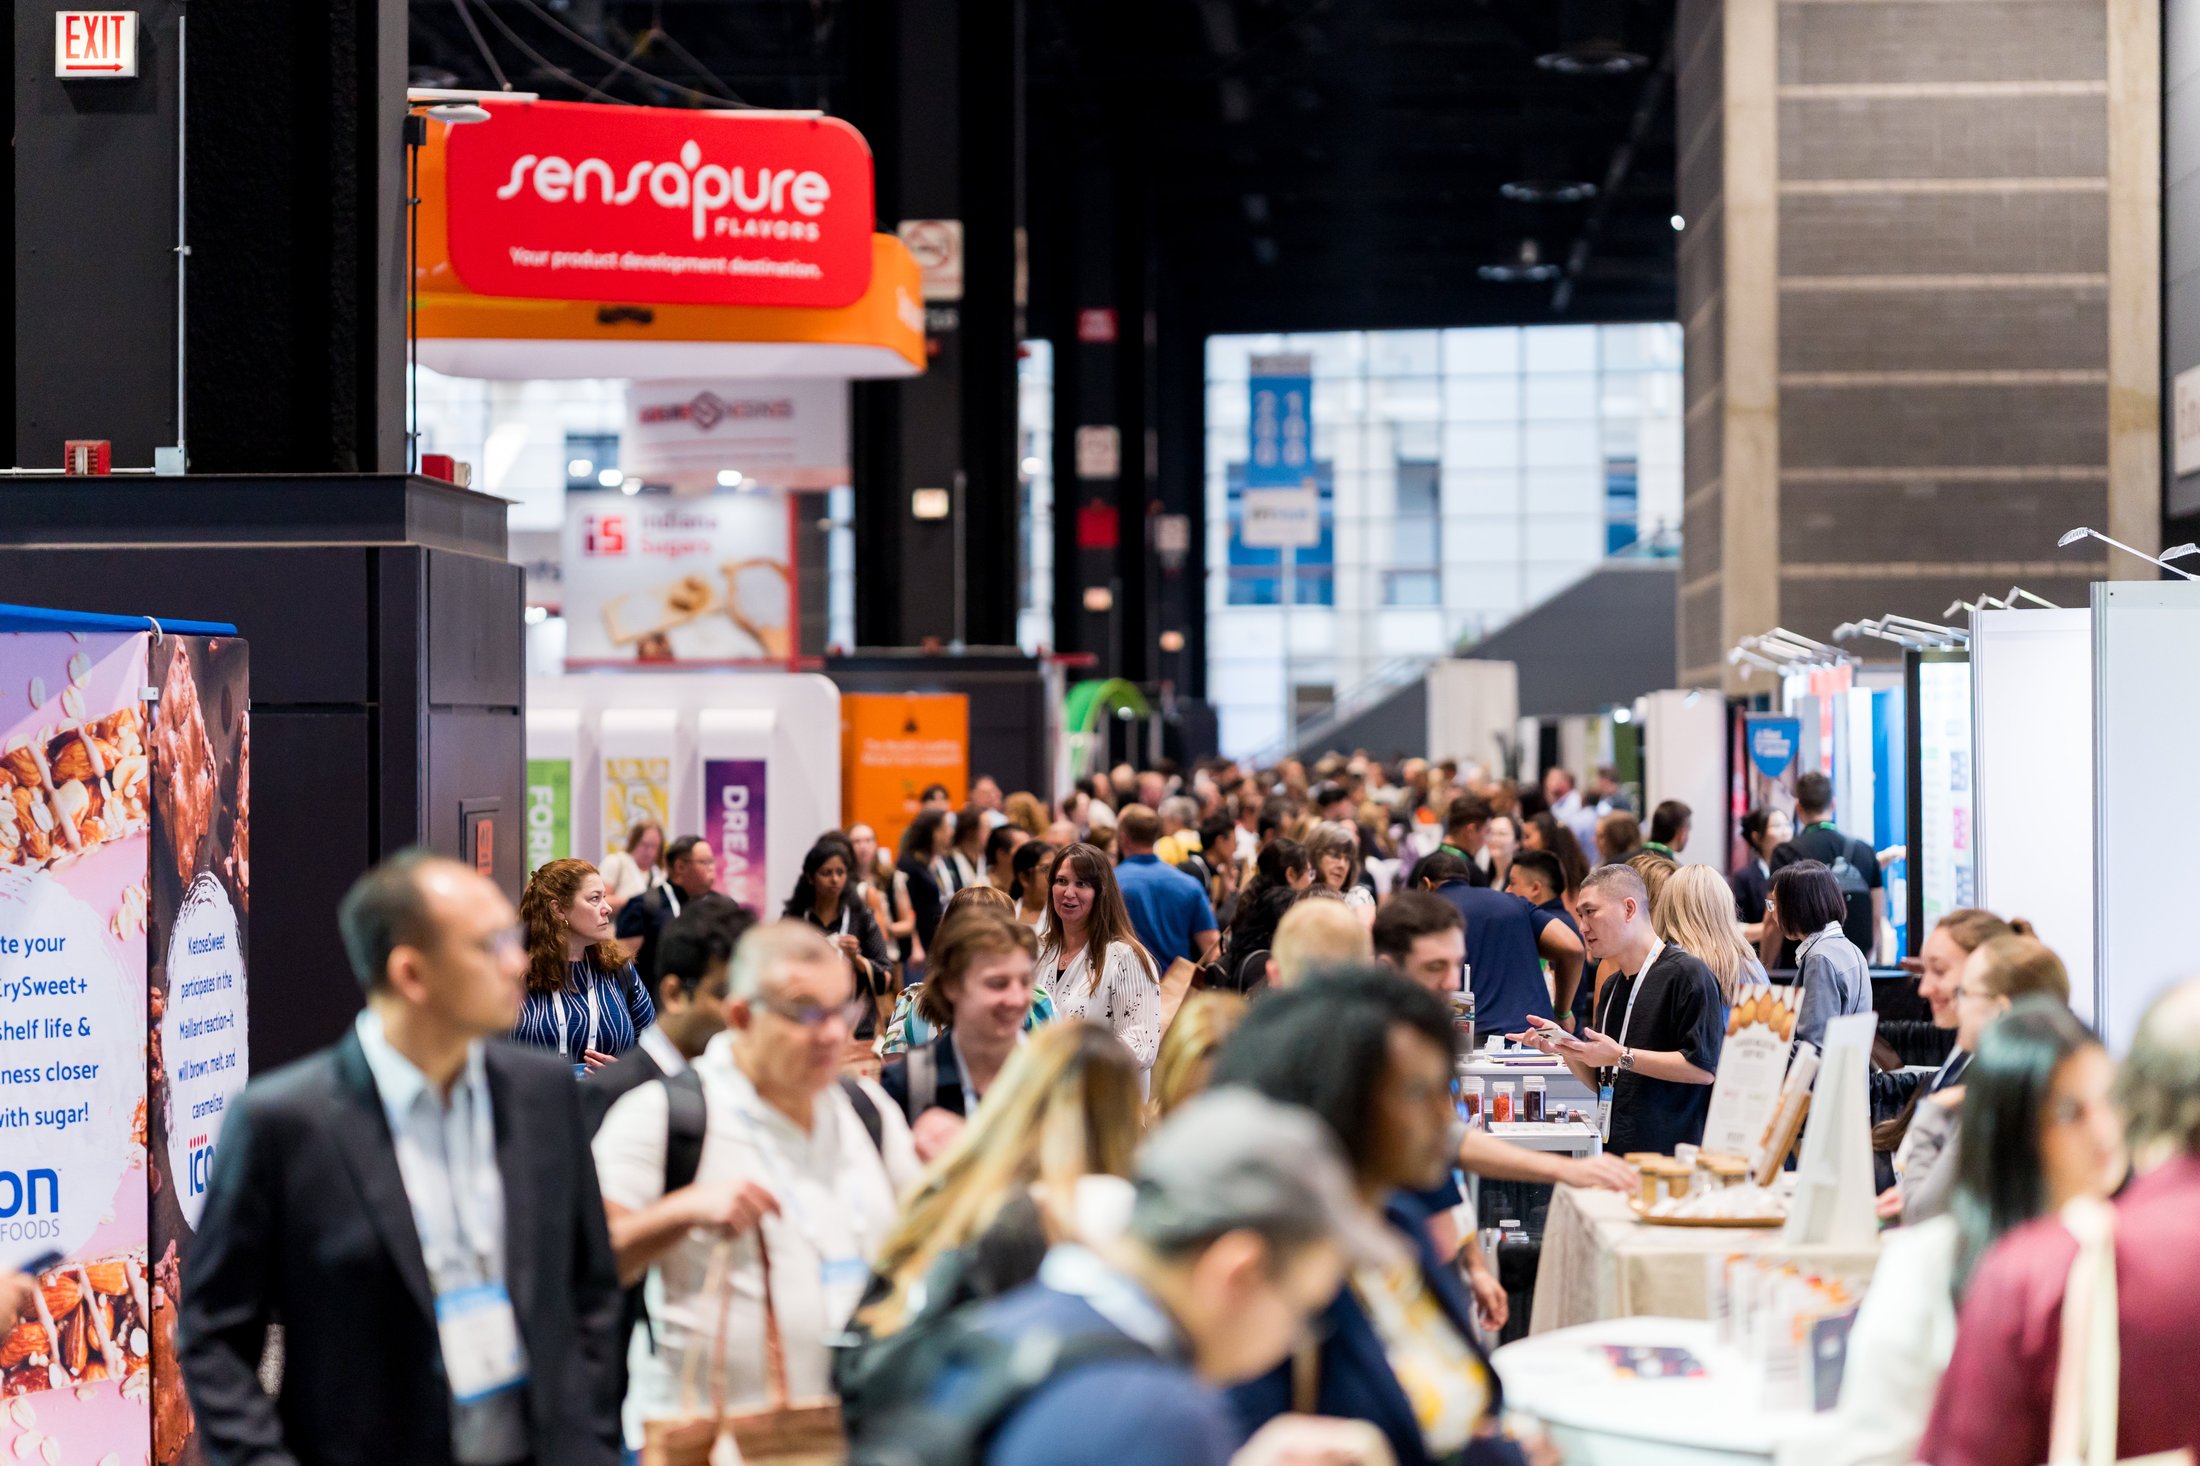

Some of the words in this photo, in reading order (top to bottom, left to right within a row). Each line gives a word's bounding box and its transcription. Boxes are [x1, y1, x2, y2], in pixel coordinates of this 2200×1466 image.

[66, 15, 125, 59] EXIT
[497, 154, 831, 241] sensapure
[714, 216, 821, 242] FLAVORS
[509, 247, 549, 267] Your
[551, 249, 618, 270] product
[619, 250, 728, 275] development
[728, 256, 823, 279] destination.
[24, 937, 66, 958] your
[188, 932, 225, 956] KetoseSweet
[181, 975, 215, 1004] participates
[216, 971, 222, 991] in
[222, 969, 232, 990] the
[45, 1018, 73, 1038] life
[78, 1017, 91, 1037] &
[179, 1016, 203, 1041] Maillard
[46, 1061, 99, 1082] closer
[178, 1060, 189, 1082] will
[189, 1058, 209, 1079] brown,
[210, 1052, 224, 1073] melt,
[225, 1048, 236, 1070] and
[35, 1102, 89, 1130] sugar!
[192, 1091, 224, 1119] caramelize!
[0, 1218, 60, 1242] FOODS
